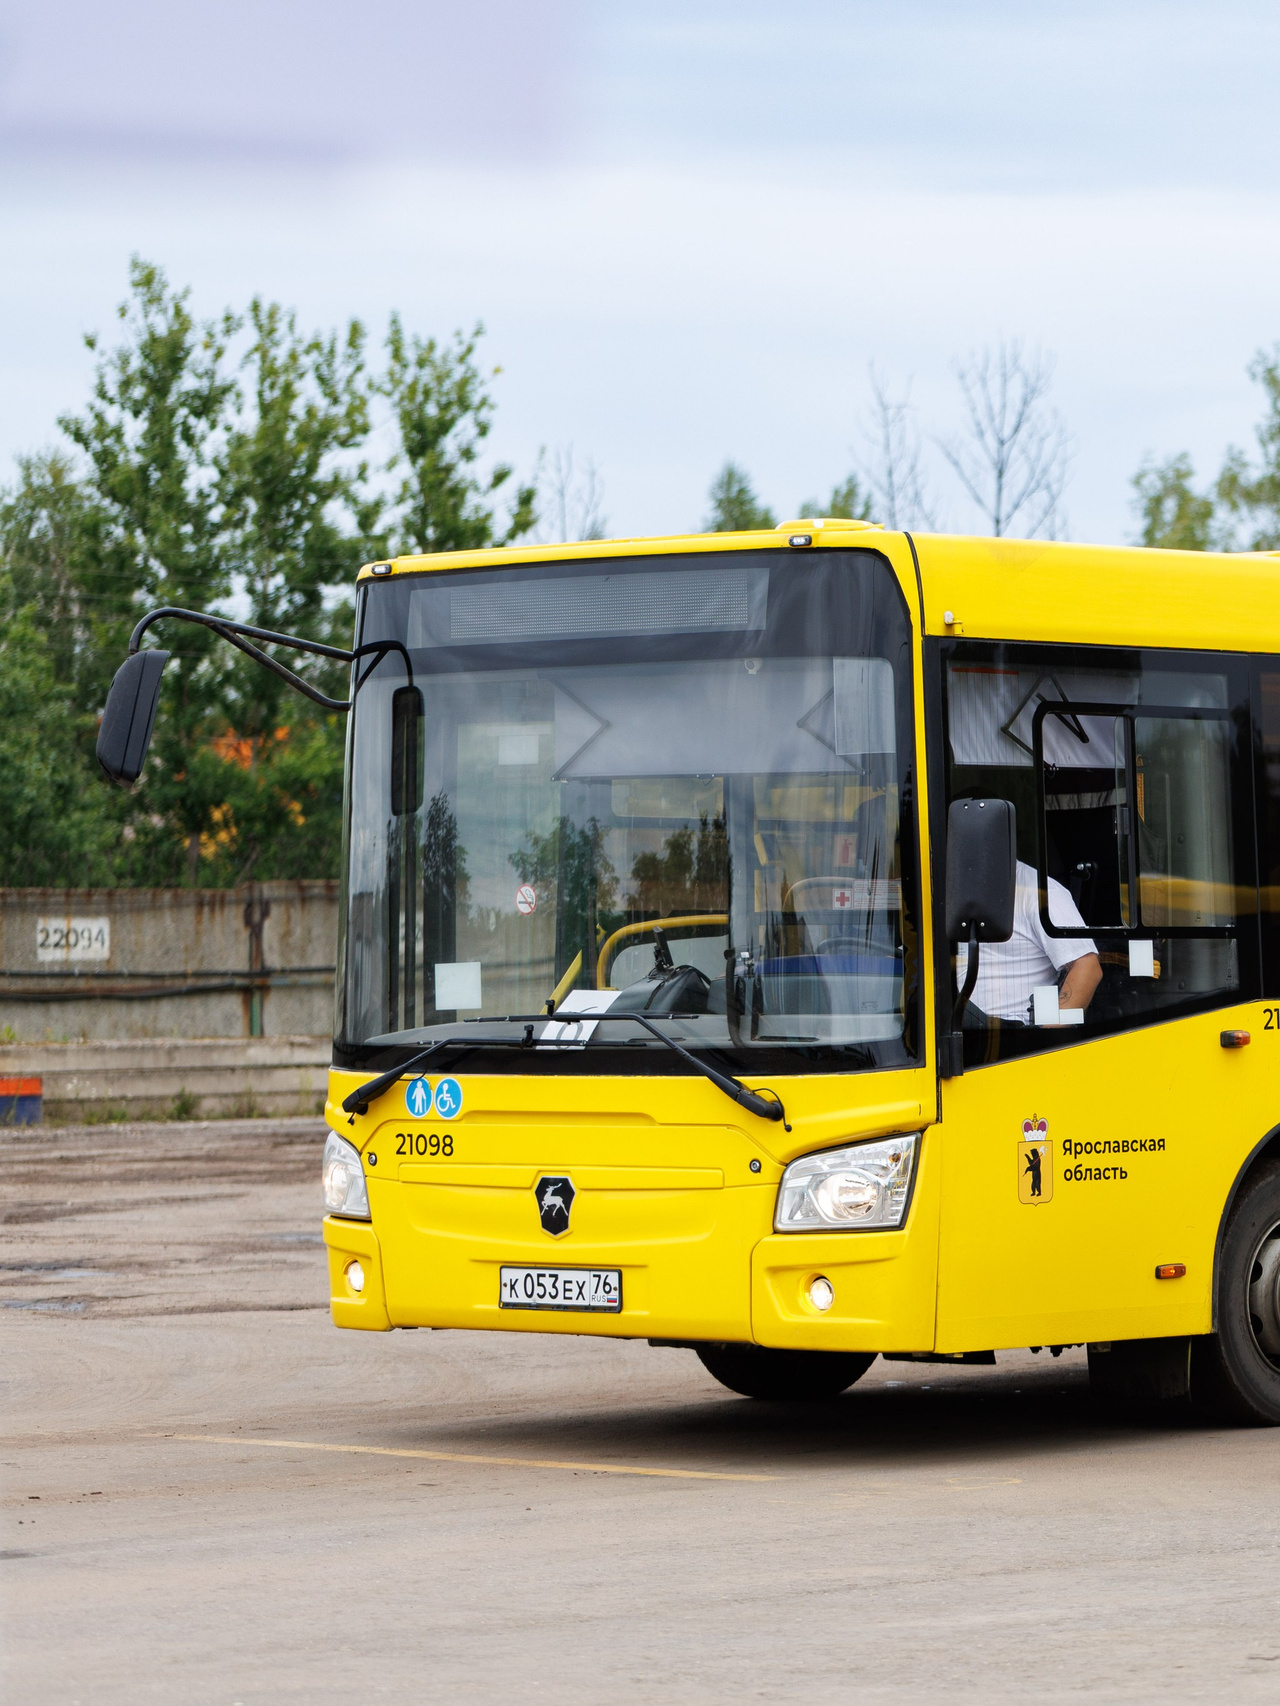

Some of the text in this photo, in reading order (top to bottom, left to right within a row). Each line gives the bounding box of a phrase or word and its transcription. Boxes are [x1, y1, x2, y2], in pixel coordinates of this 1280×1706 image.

[395, 1133, 454, 1157] 21098
[1062, 1138, 1166, 1160] Ярославская
[1063, 1163, 1128, 1182] область
[592, 1274, 612, 1295] 76
